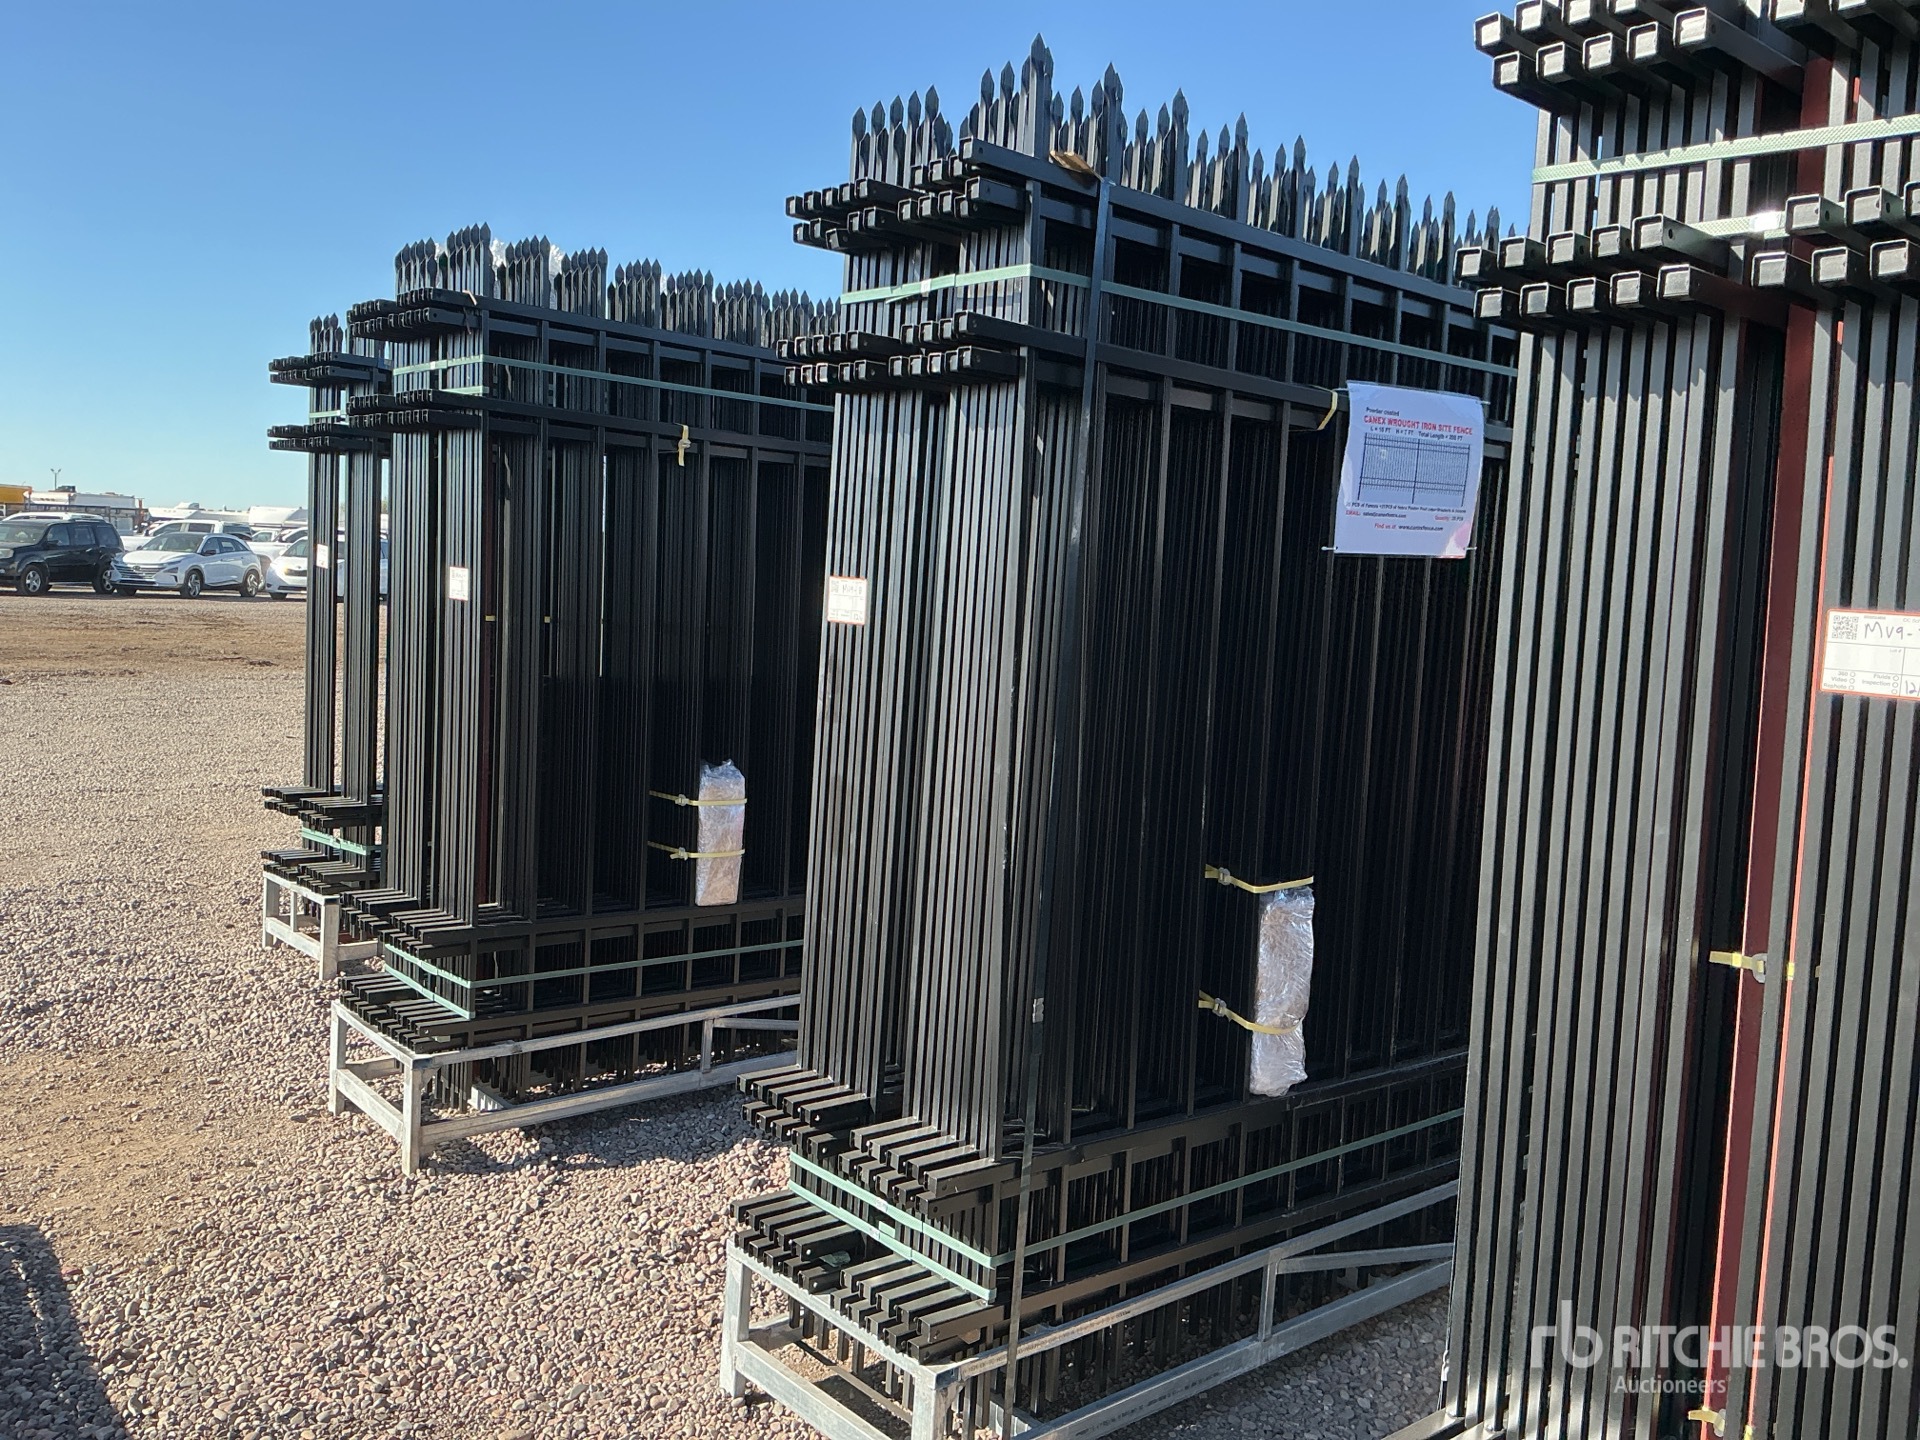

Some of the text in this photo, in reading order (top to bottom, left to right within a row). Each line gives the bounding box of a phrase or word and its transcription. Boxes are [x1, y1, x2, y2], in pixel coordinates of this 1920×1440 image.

[1364, 415, 1473, 435] CANEX WROUGHT IRON SITE FENCE
[1864, 621, 1920, 640] MV9-
[1862, 679, 1891, 687] Inspection
